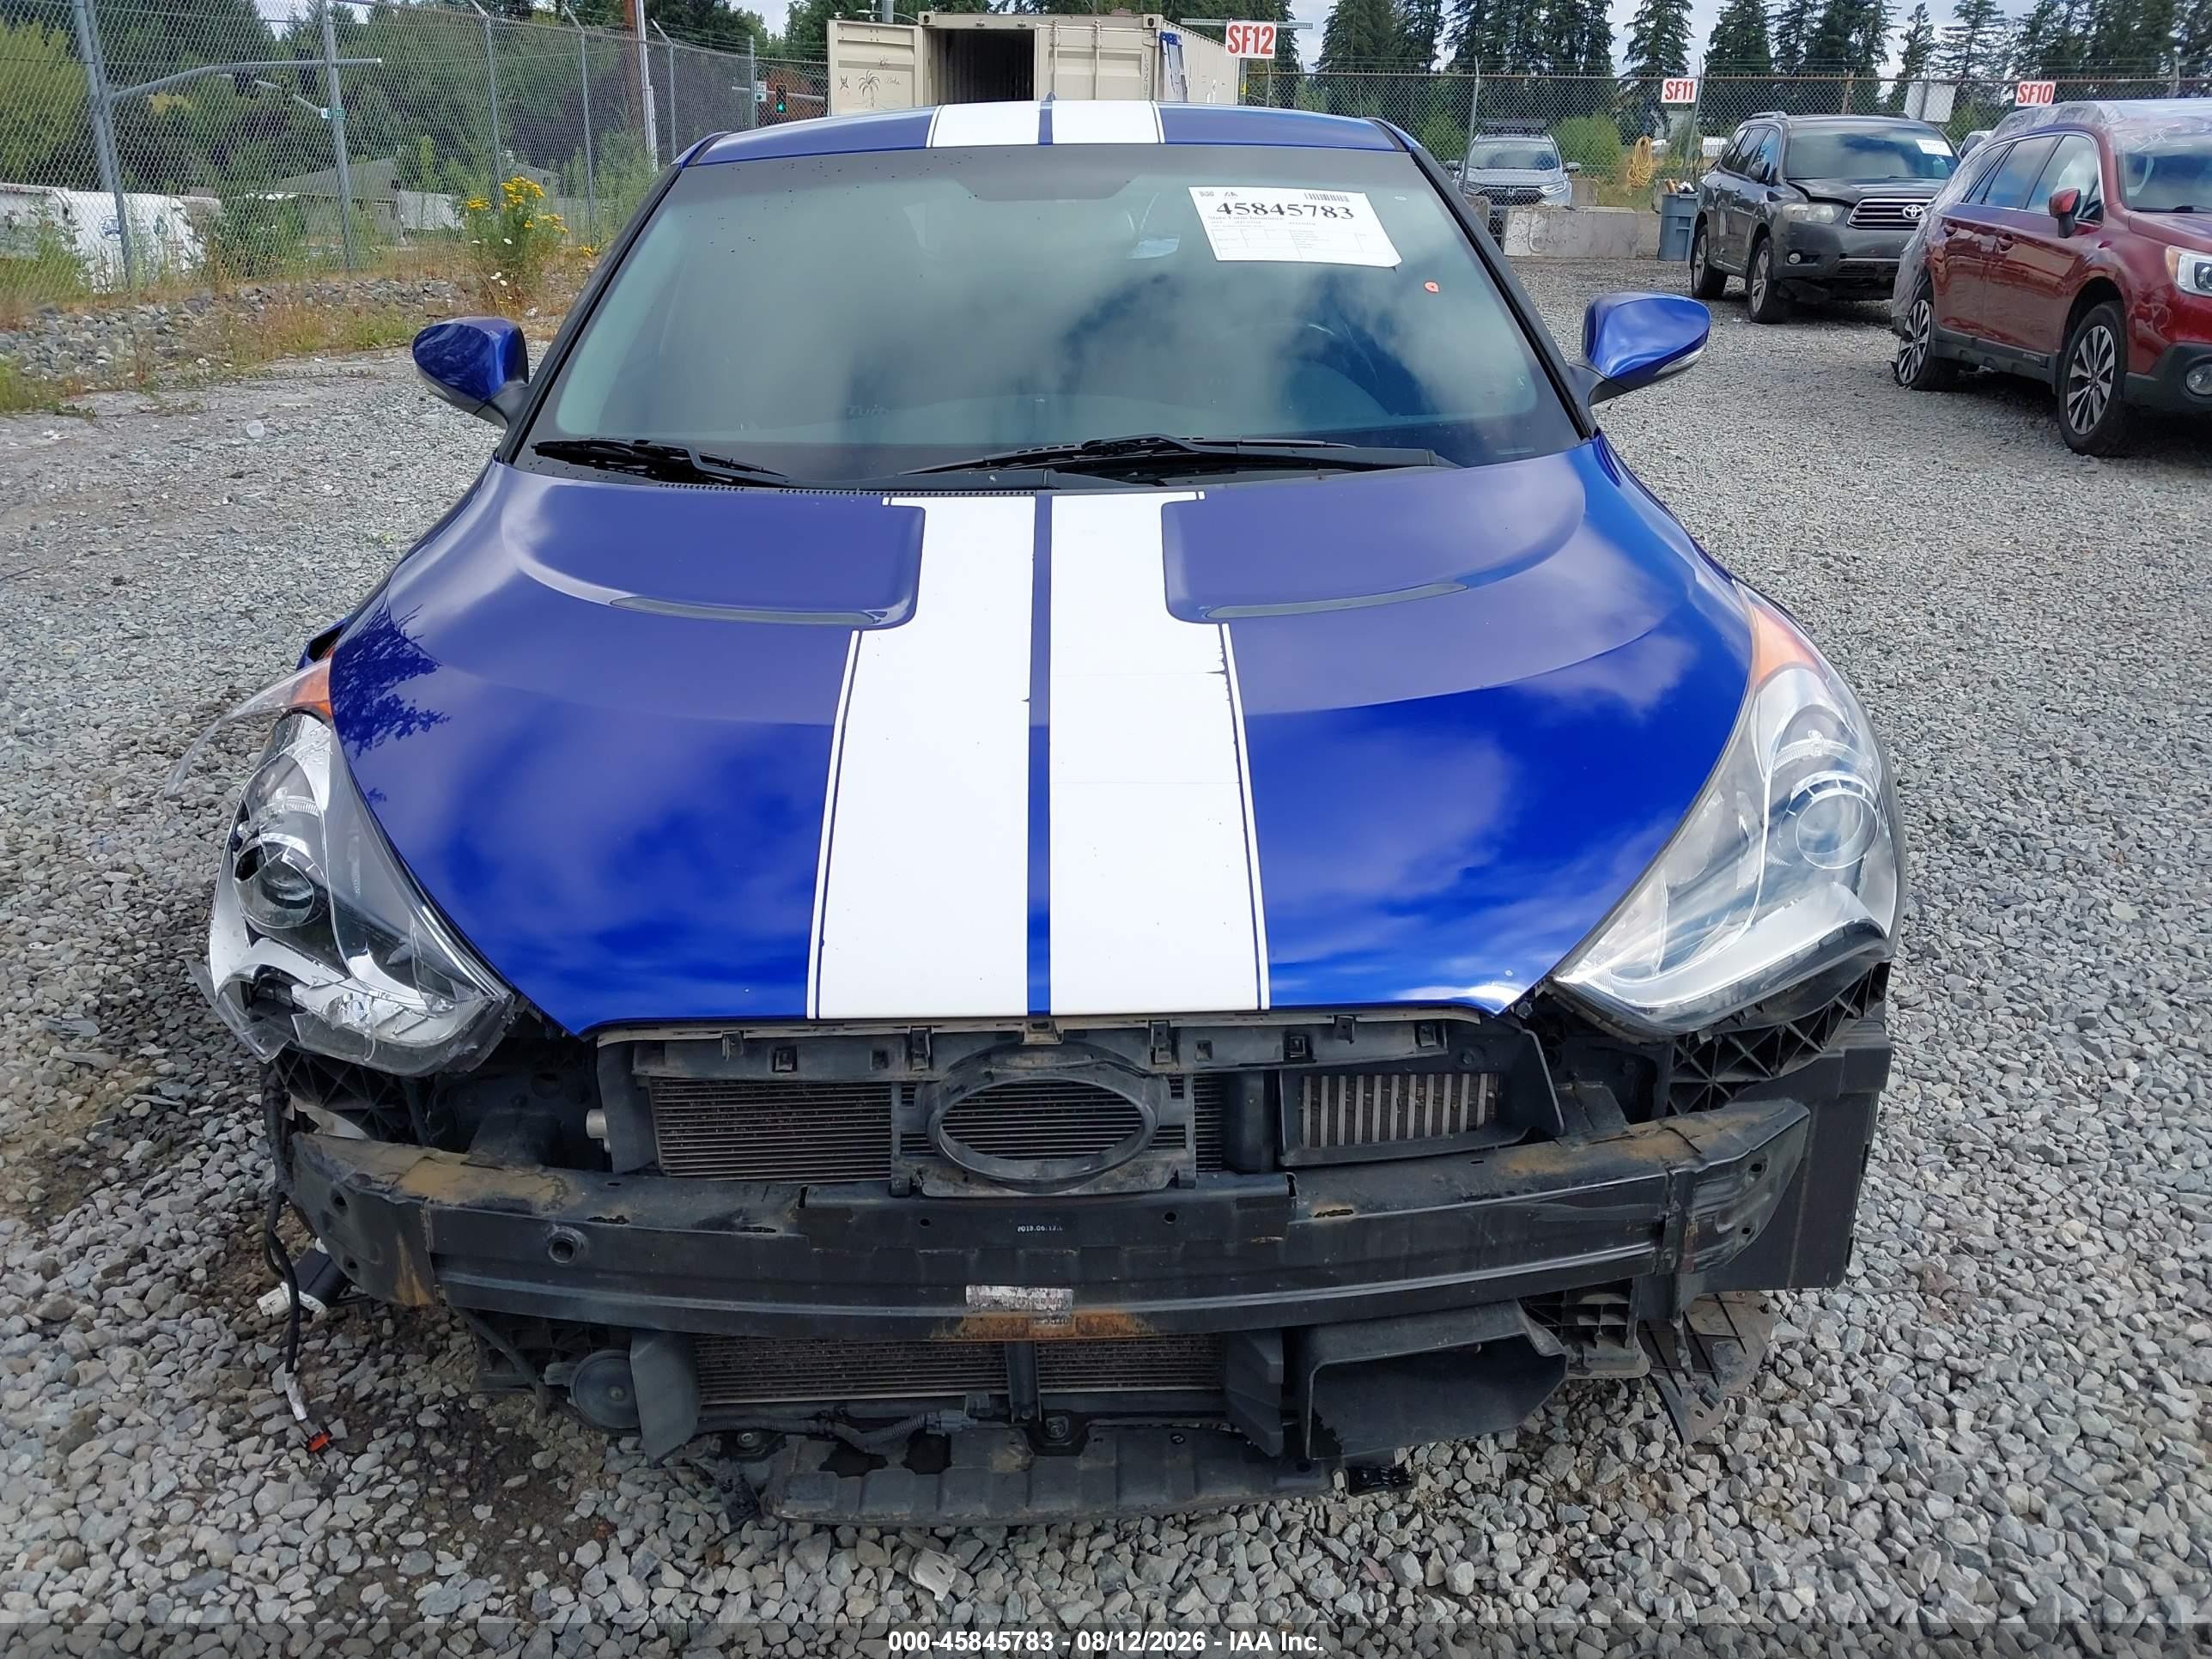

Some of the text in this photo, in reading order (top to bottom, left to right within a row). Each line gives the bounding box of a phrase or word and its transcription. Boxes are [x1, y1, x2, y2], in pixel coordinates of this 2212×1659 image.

[1227, 24, 1274, 54] SF12
[1665, 81, 1694, 100] SF11
[2017, 83, 2053, 104] SF10
[1216, 202, 1354, 220] 45845783
